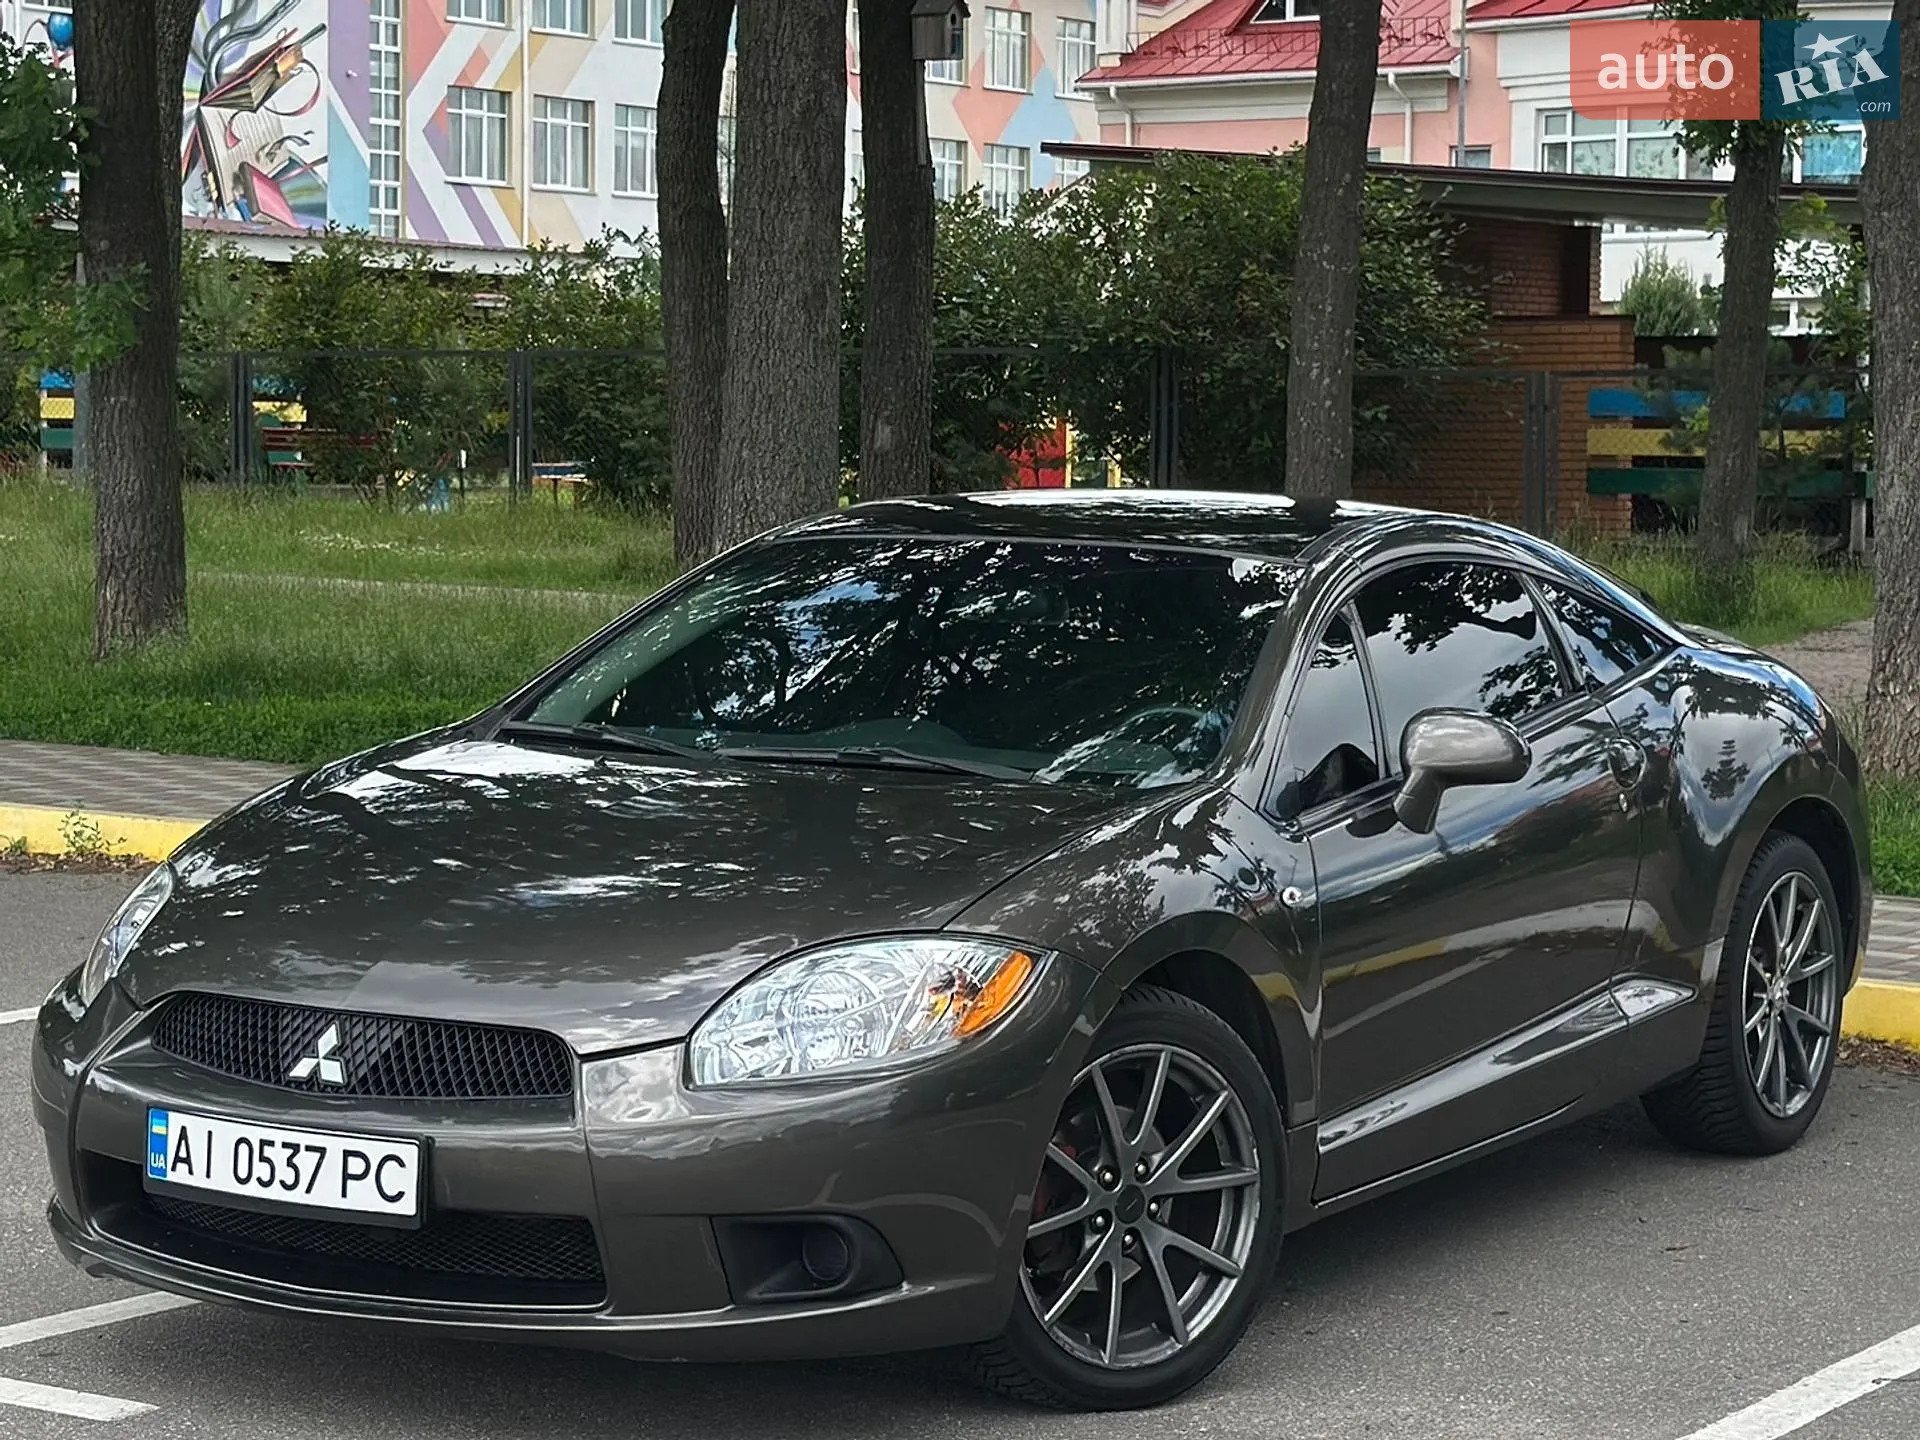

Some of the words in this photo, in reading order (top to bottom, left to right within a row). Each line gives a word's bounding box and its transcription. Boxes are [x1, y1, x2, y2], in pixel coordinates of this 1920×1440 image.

[151, 1152, 166, 1170] UA
[170, 1125, 213, 1179] AI
[233, 1137, 327, 1195] 0537
[341, 1149, 407, 1204] PC
